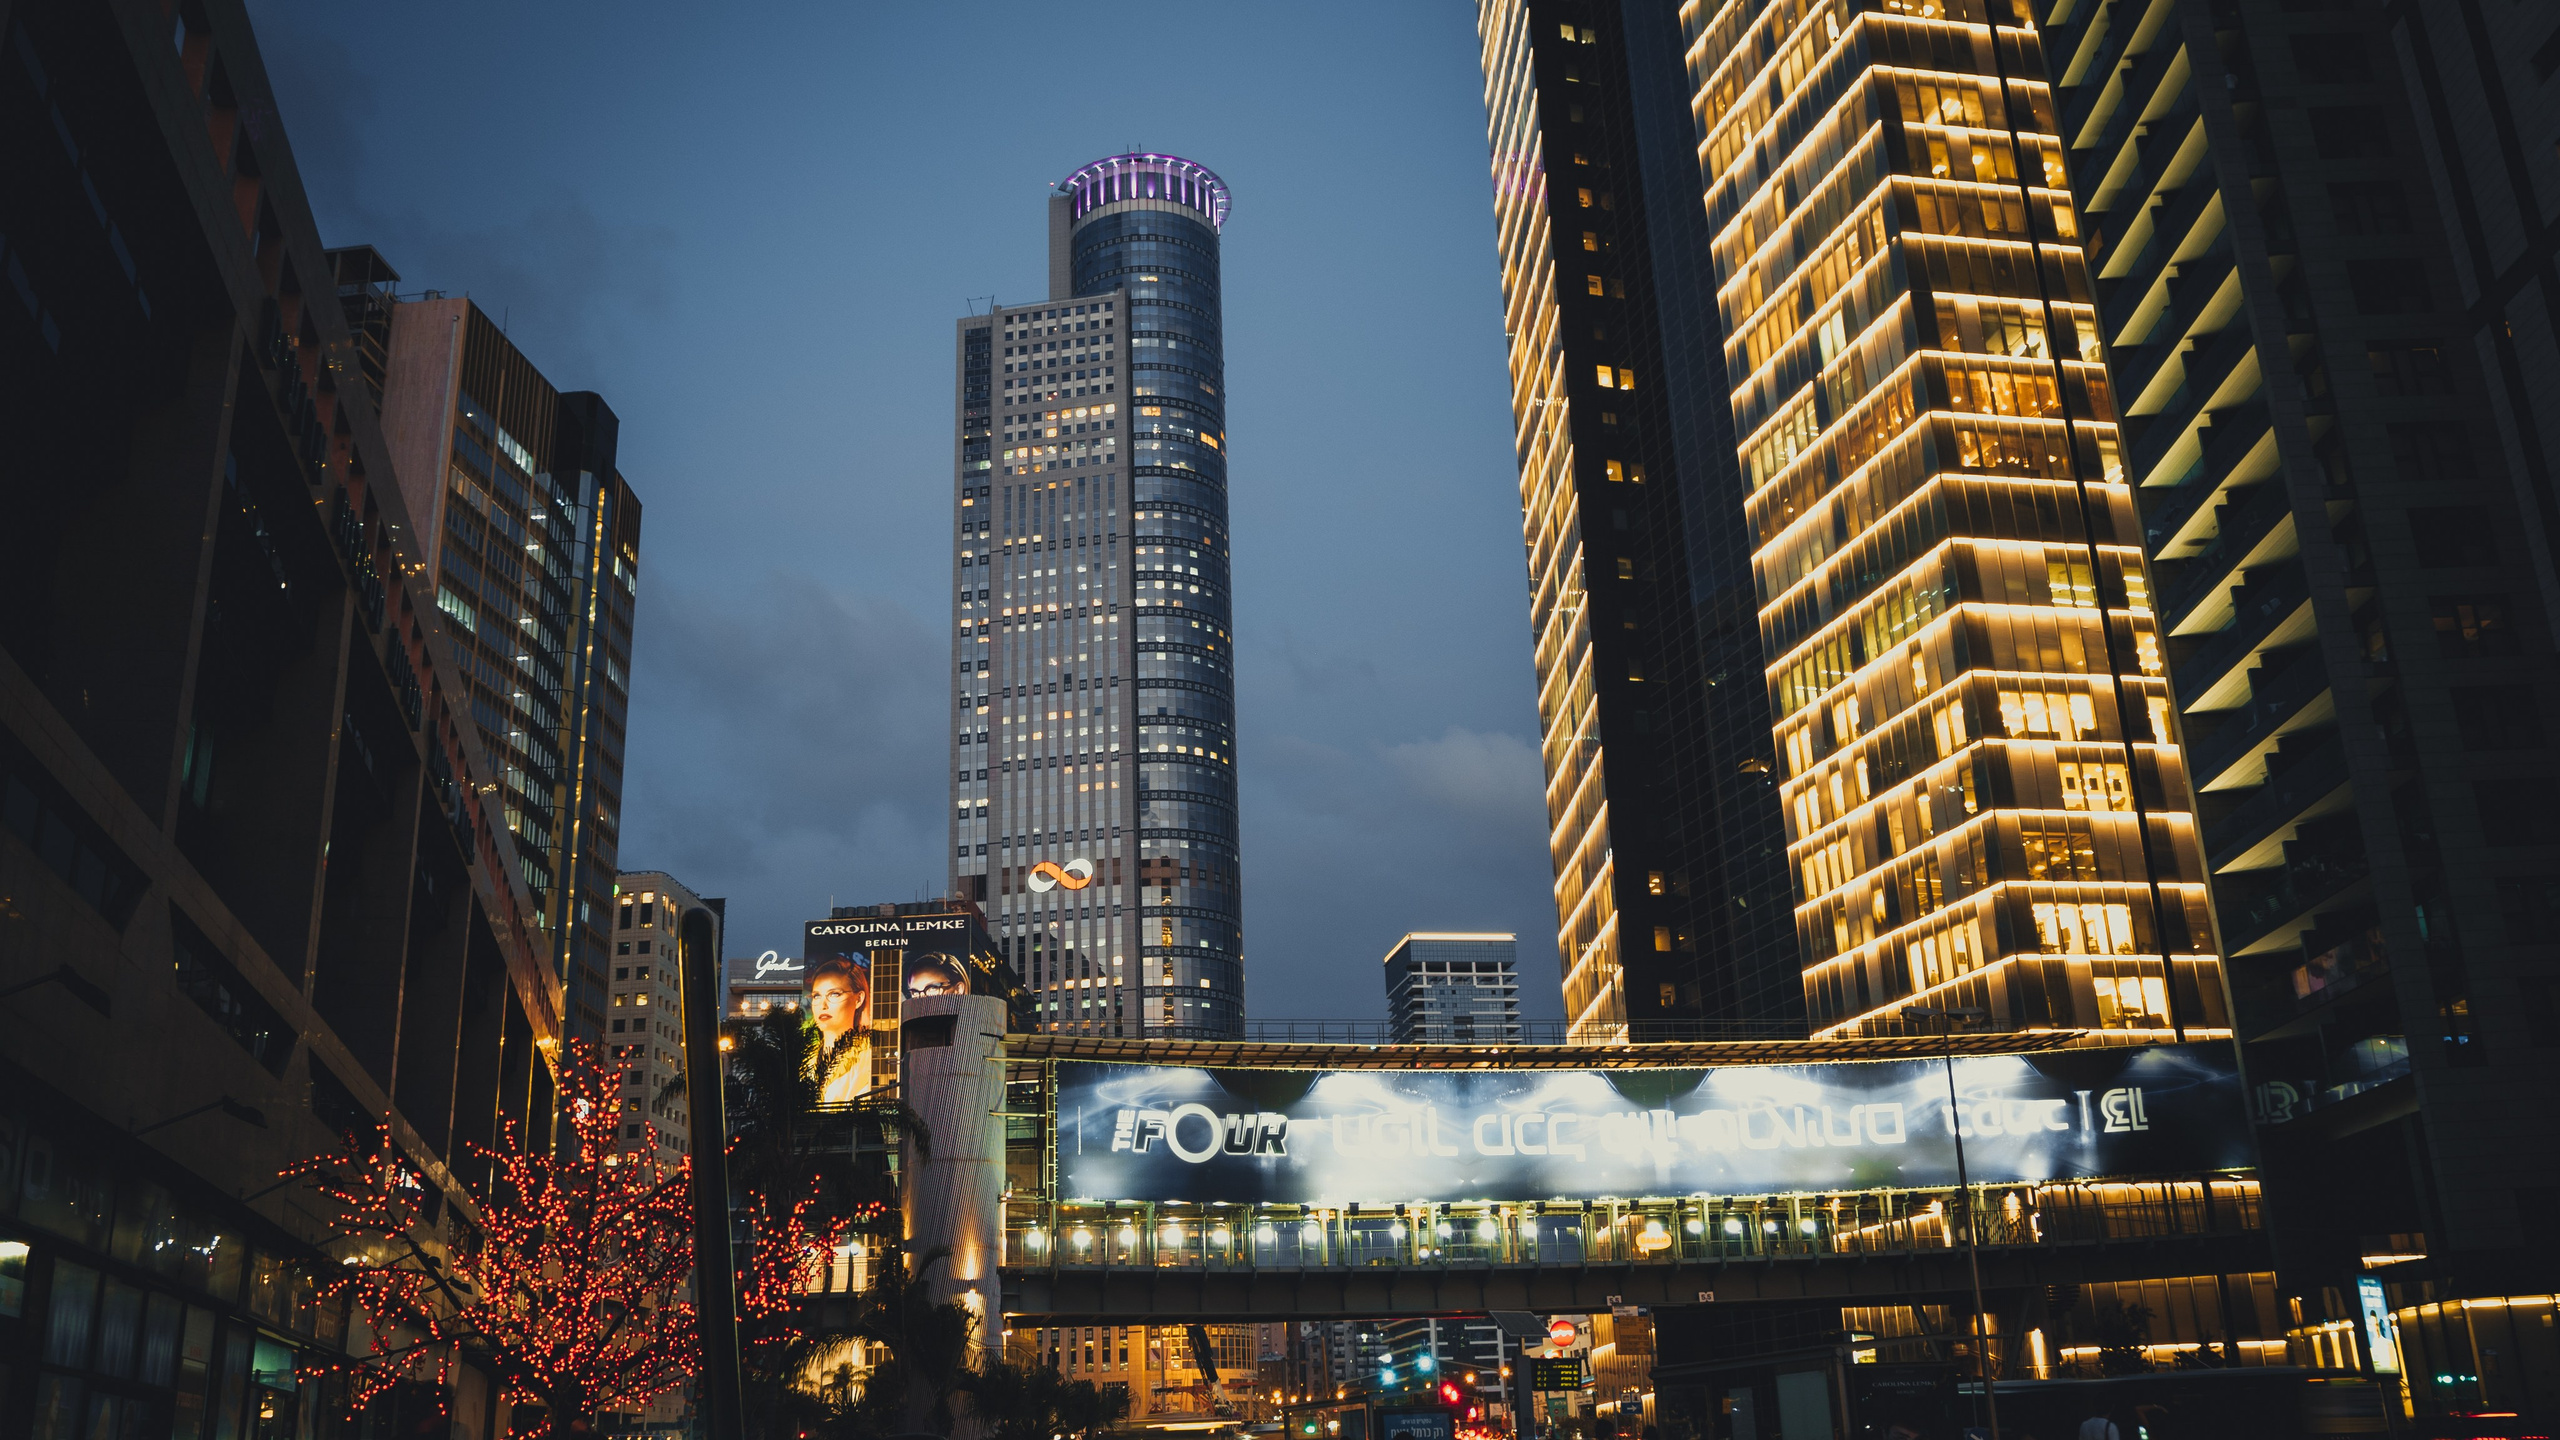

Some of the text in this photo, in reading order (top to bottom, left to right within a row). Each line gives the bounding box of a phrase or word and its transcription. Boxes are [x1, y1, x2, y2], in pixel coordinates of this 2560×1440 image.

[810, 919, 965, 936] CAROLINA LEMKE
[864, 938, 909, 948] BERLIN
[1112, 1108, 1133, 1152] THE
[1133, 1103, 1288, 1164] FOUR
